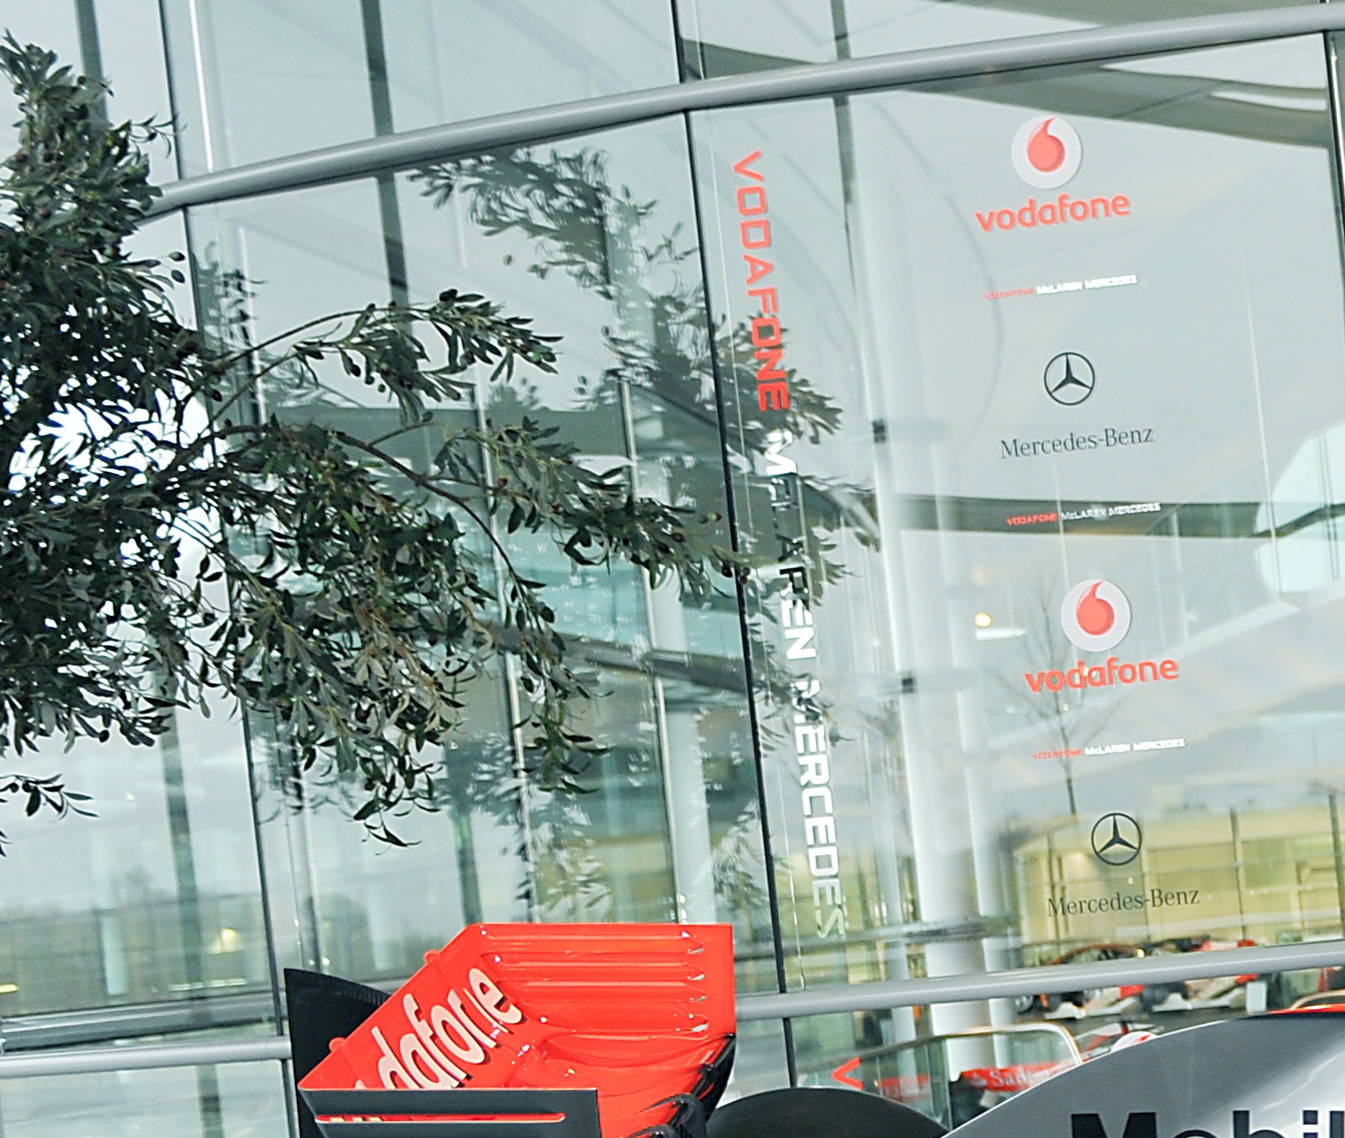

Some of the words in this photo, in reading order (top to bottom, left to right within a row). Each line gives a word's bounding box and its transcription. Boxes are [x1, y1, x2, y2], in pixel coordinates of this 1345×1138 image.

[975, 194, 1131, 232] vodafone
[733, 149, 790, 412] VODAFONE
[1000, 427, 1154, 459] Mercedes-Benz
[1006, 512, 1058, 527] VODAFONE
[1024, 656, 1179, 693] vodafone
[1047, 887, 1200, 918] Mercedes-Benz
[370, 967, 522, 1089] dafone
